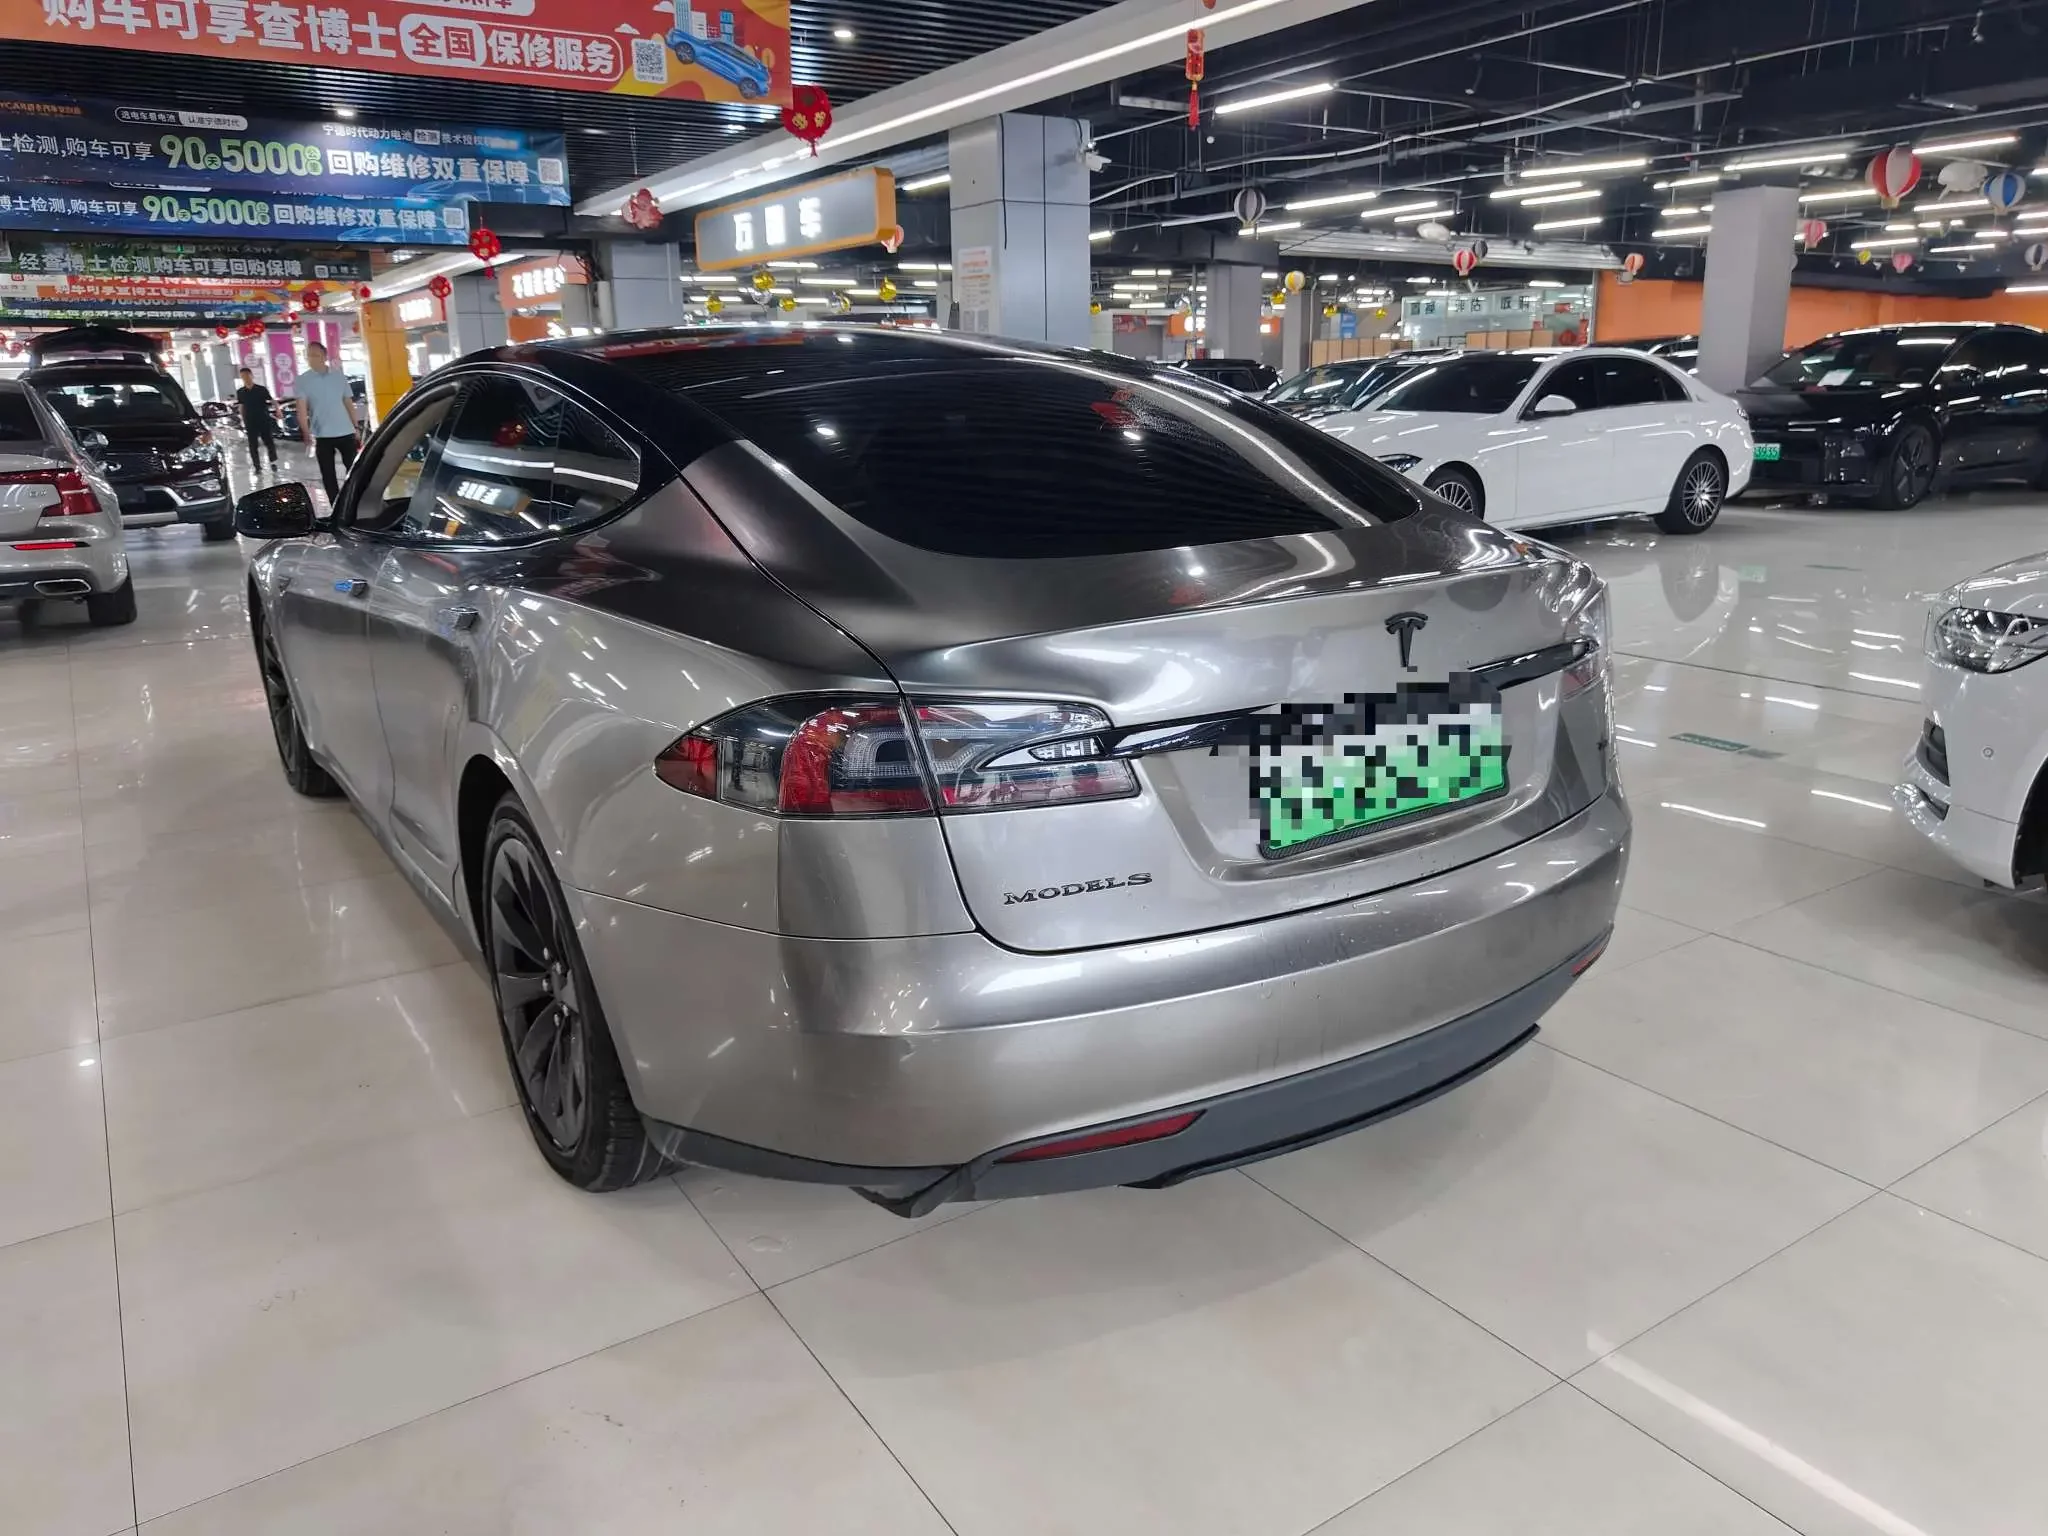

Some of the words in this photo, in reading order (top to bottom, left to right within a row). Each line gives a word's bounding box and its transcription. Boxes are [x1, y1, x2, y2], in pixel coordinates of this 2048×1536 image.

[43, 0, 397, 59] 购车可享查博士
[408, 22, 477, 62] 全国
[487, 29, 615, 75] 保修服务
[326, 148, 530, 184] 回购维修双重保障
[273, 203, 436, 229] 回购维修双重保障
